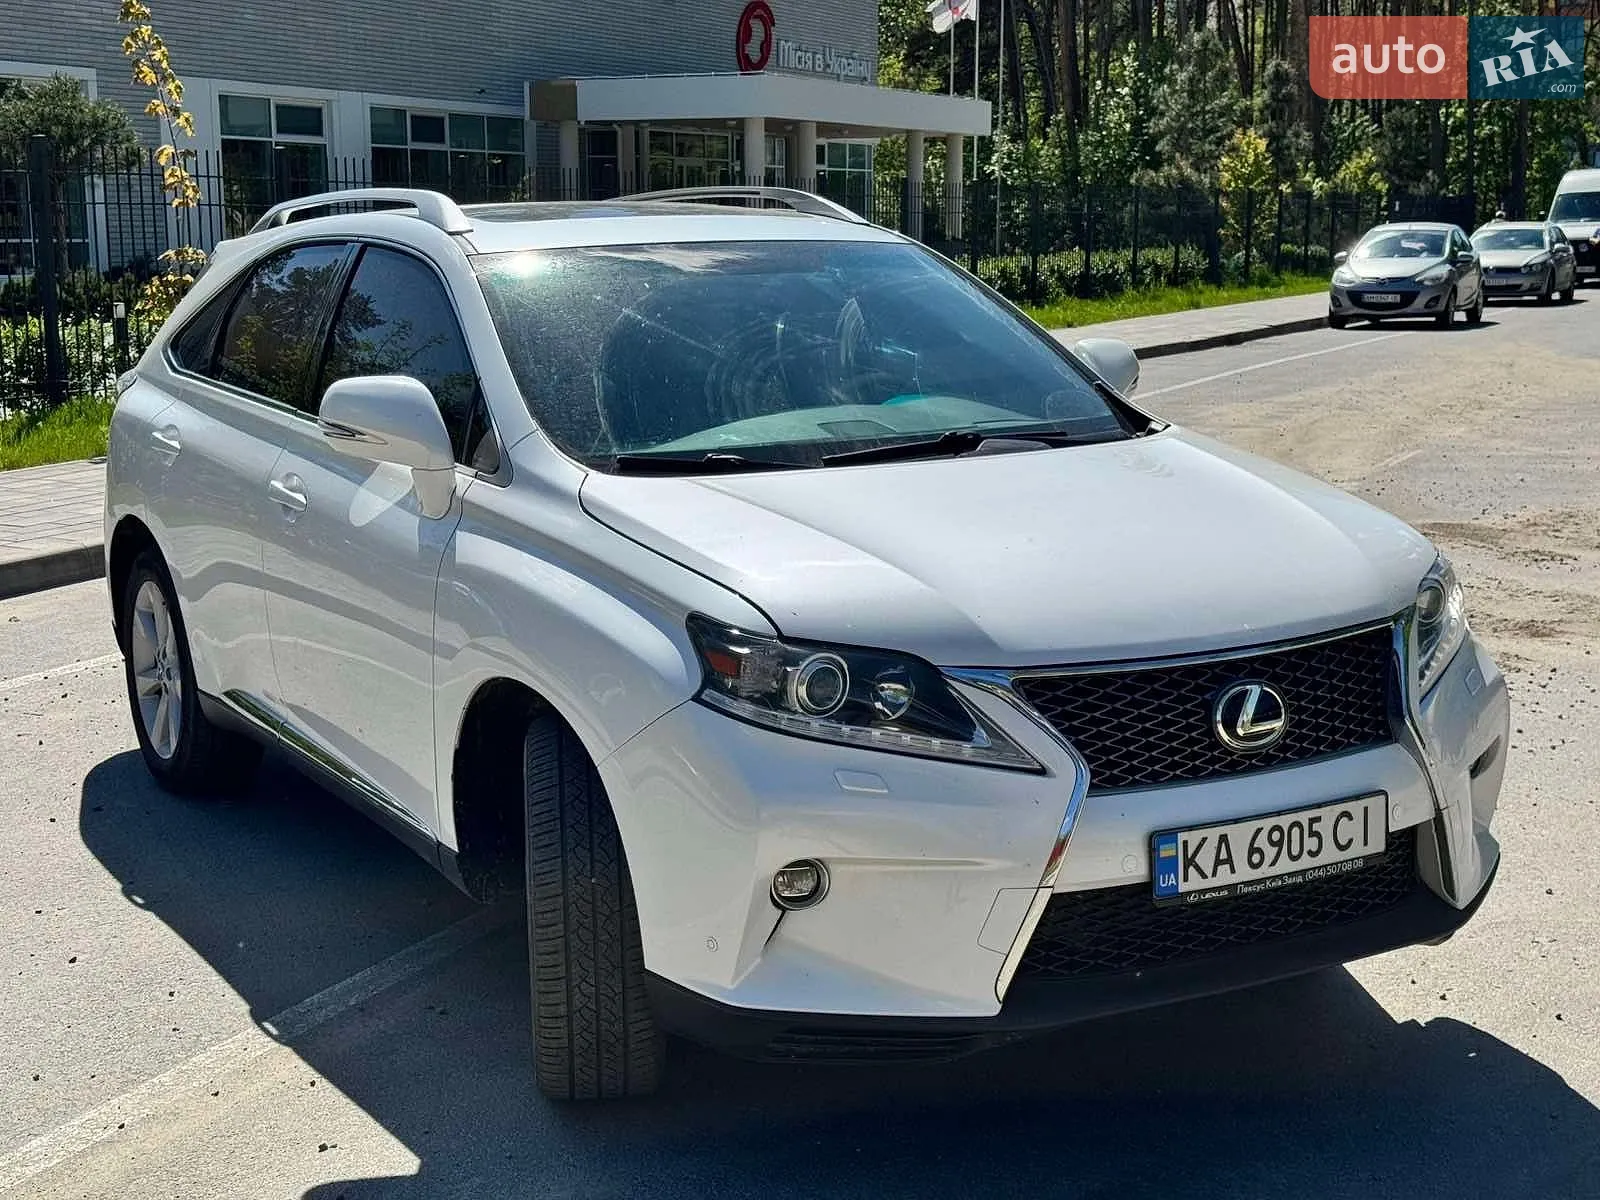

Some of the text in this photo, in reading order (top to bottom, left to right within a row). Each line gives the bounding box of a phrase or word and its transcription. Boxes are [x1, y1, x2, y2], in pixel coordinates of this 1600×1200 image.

[780, 40, 813, 71] Місія
[815, 54, 824, 72] в
[1182, 806, 1369, 883] KA 6905 CI
[1159, 872, 1177, 888] UA
